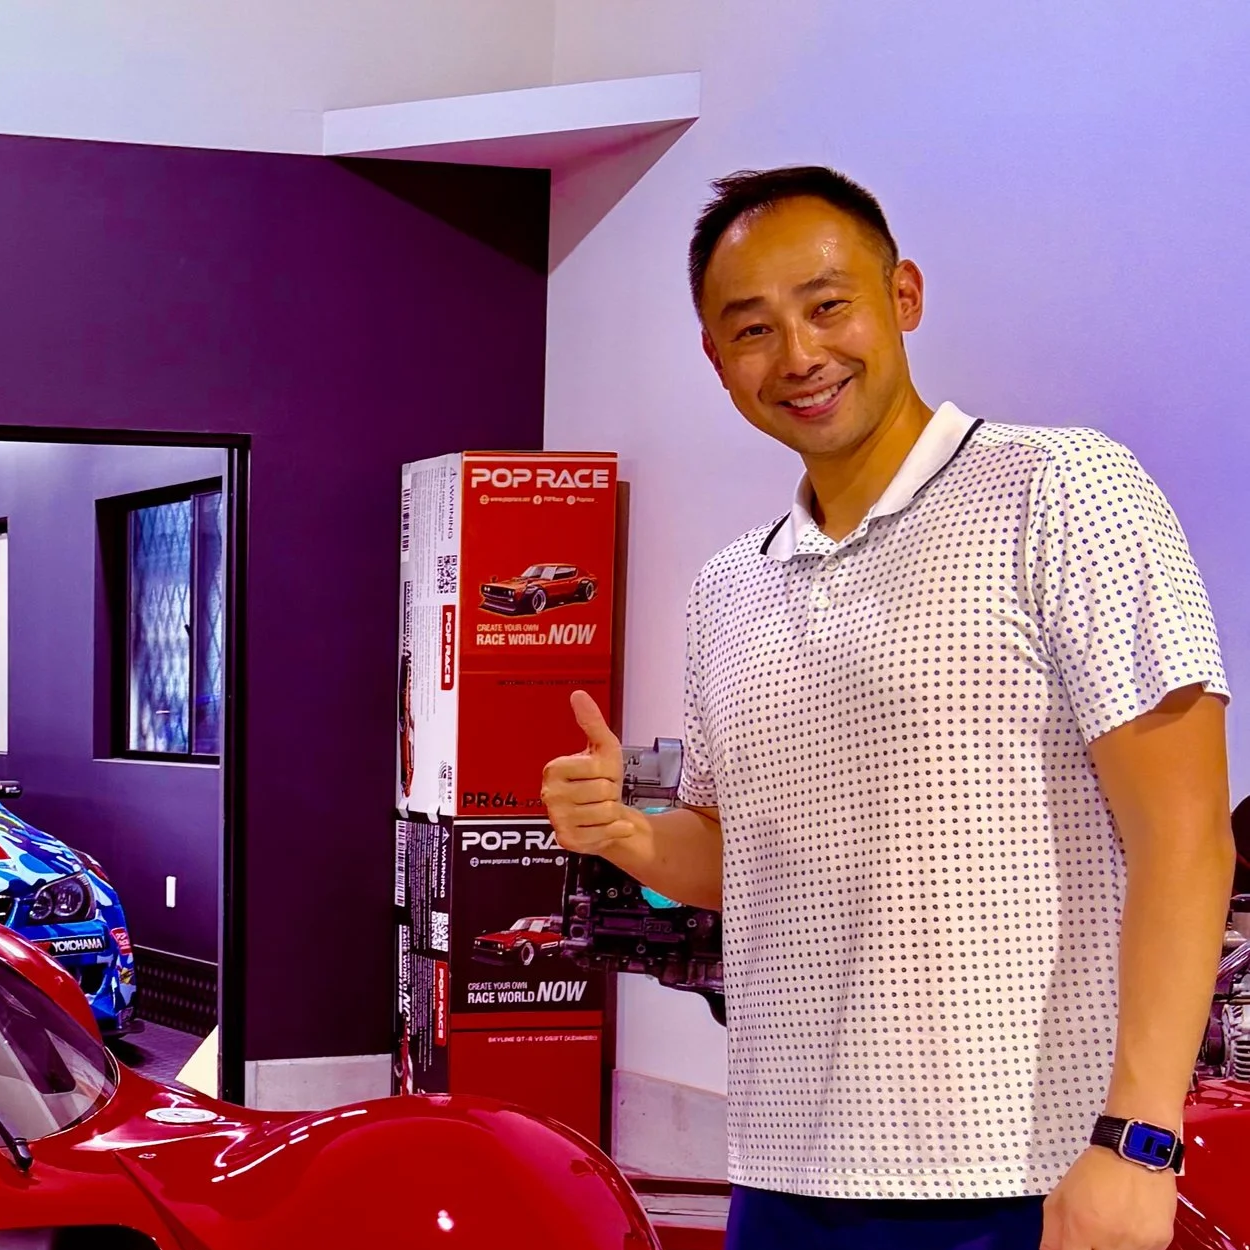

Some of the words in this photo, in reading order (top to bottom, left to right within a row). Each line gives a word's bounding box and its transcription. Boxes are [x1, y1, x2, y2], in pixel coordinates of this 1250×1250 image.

[471, 468, 532, 488] POP
[536, 469, 609, 488] RACE
[445, 612, 453, 643] POP
[476, 624, 503, 632] CREATE
[504, 624, 522, 632] YOUR
[476, 634, 505, 645] RACE
[508, 633, 546, 645] WORLD
[547, 624, 597, 645] NOW
[444, 644, 452, 684] RACE
[462, 792, 517, 808] PR64
[462, 831, 521, 851] POP
[525, 831, 566, 850] RA
[439, 844, 447, 898] WARNING
[52, 938, 103, 952] YOKOHAMA
[467, 982, 492, 990] CREATE
[493, 982, 510, 990] YOUR
[512, 981, 527, 989] OWN
[467, 992, 495, 1003] RACE
[498, 991, 534, 1003] WORLD
[536, 981, 587, 1002] NOW
